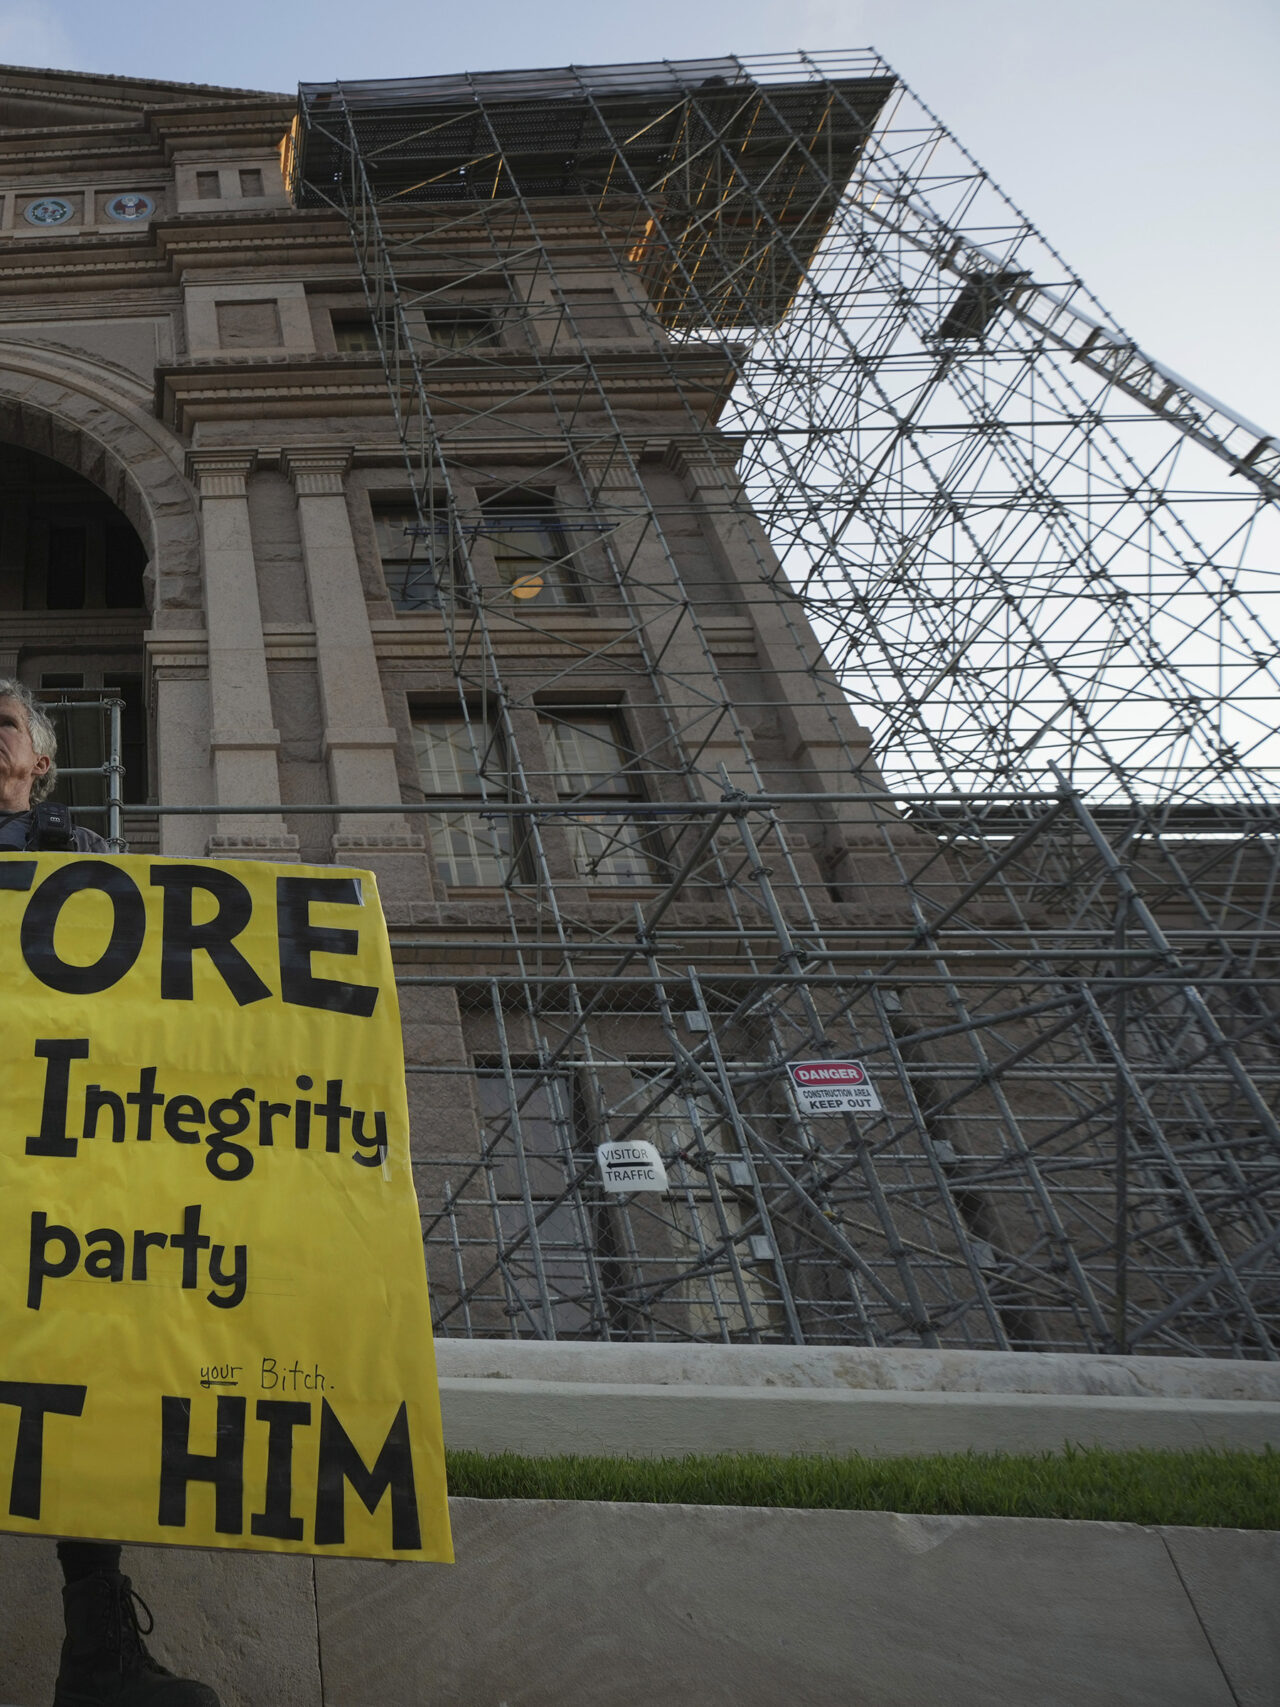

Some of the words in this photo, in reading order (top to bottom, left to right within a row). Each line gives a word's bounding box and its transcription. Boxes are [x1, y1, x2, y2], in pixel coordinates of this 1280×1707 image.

[798, 1068, 859, 1080] DANGER
[802, 1089, 853, 1099] CONSTRUCTION
[854, 1088, 871, 1097] AREA
[25, 1039, 387, 1181] Integrity
[809, 1100, 843, 1110] KEEP
[847, 1099, 872, 1108] OUT
[601, 1148, 649, 1160] VISITOR
[605, 1169, 655, 1181] TRAFFIC
[27, 1205, 246, 1310] party
[200, 1363, 243, 1389] your
[261, 1357, 335, 1391] Bitch.
[158, 1396, 422, 1550] HIM
